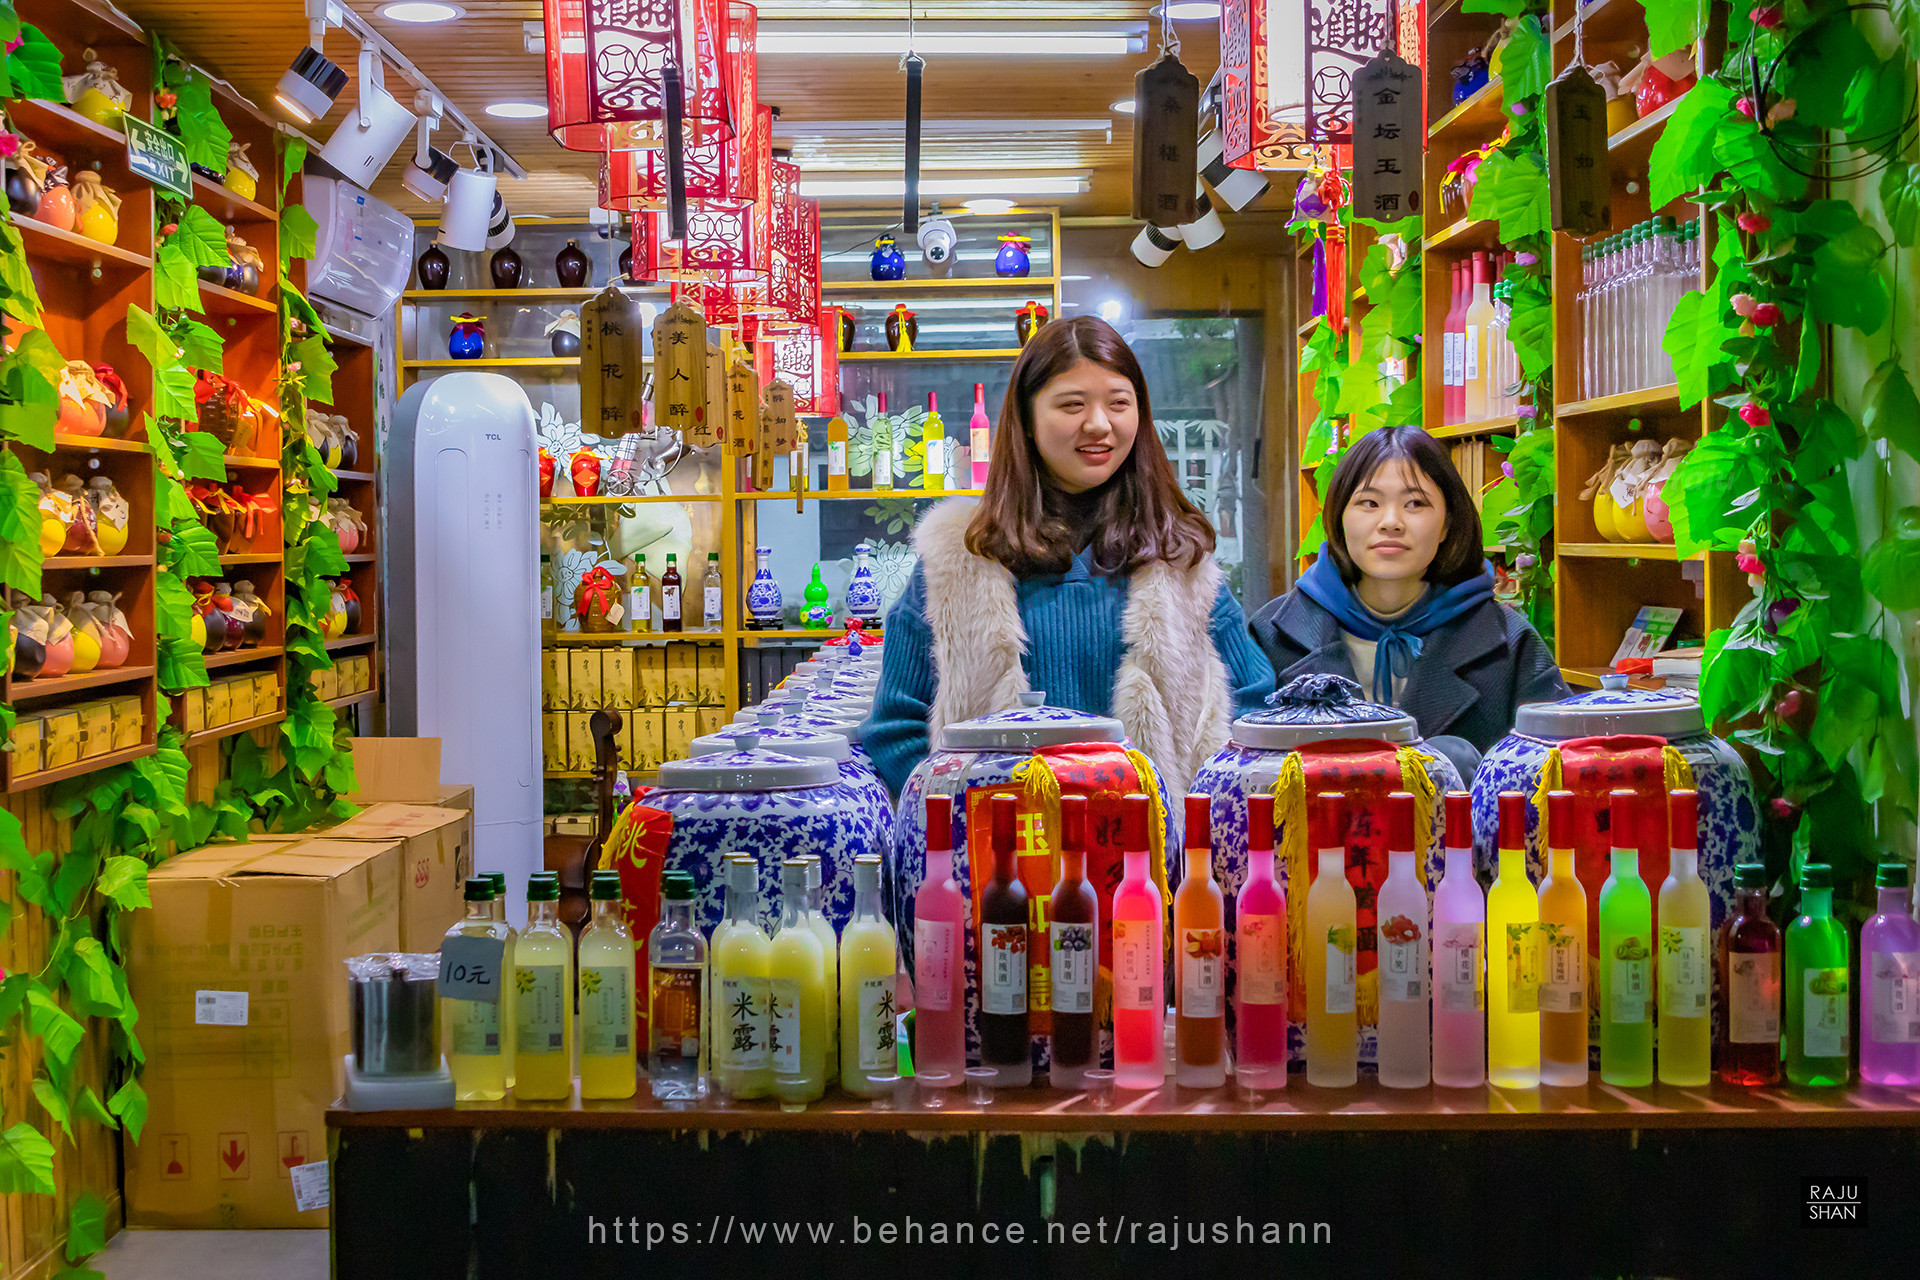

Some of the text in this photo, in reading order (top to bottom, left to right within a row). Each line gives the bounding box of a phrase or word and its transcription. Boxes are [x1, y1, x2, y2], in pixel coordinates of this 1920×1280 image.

[144, 130, 175, 162] 安全出口
[149, 157, 175, 182] EXIT
[1373, 87, 1401, 211] 金坛玉酒
[601, 321, 624, 421] 桃花醉
[669, 331, 690, 417] 美人醉
[731, 383, 745, 448] 桂花酒
[446, 961, 491, 985] 10元
[731, 991, 759, 1053] 米露
[877, 990, 896, 1051] 米露
